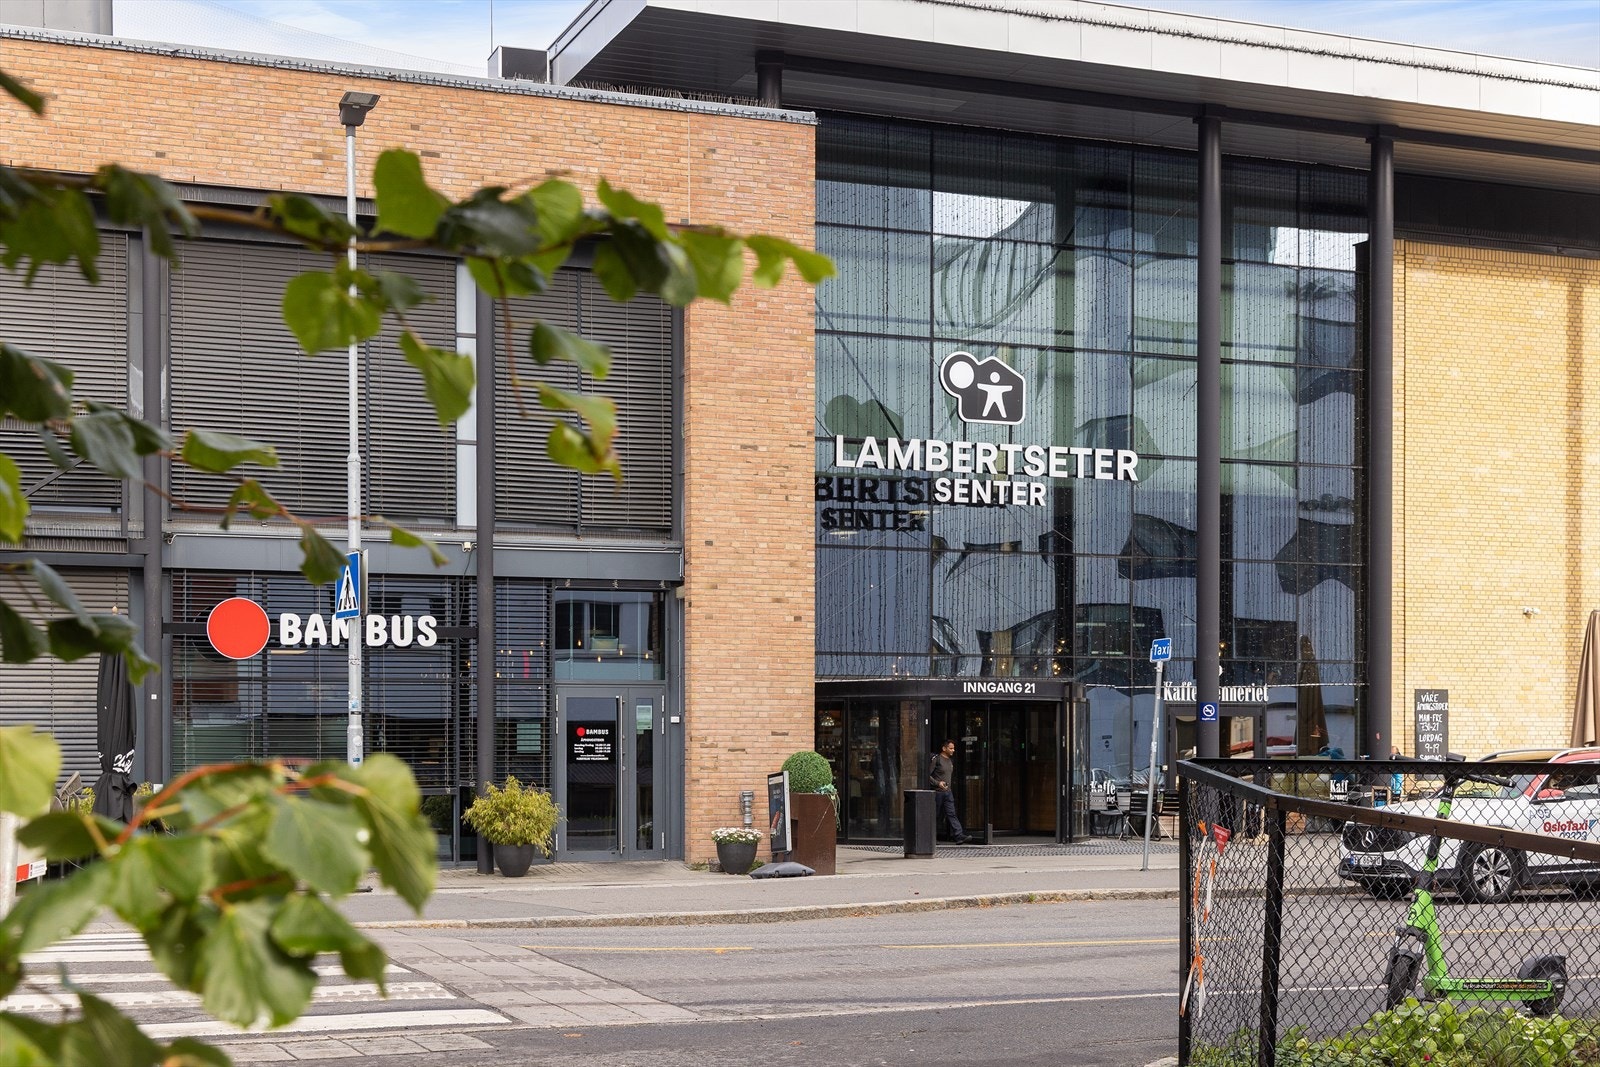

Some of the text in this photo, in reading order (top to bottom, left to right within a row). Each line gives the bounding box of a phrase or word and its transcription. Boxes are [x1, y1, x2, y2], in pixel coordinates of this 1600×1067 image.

[835, 434, 1139, 482] LAMBERTSETER
[934, 477, 1047, 507] SENTER
[1153, 642, 1170, 656] Taxi
[963, 681, 1036, 694] INNGANG 21
[1418, 733, 1443, 743] LØRDAG
[1424, 743, 1440, 754] 9-19
[1543, 819, 1588, 832] OsloTaxi
